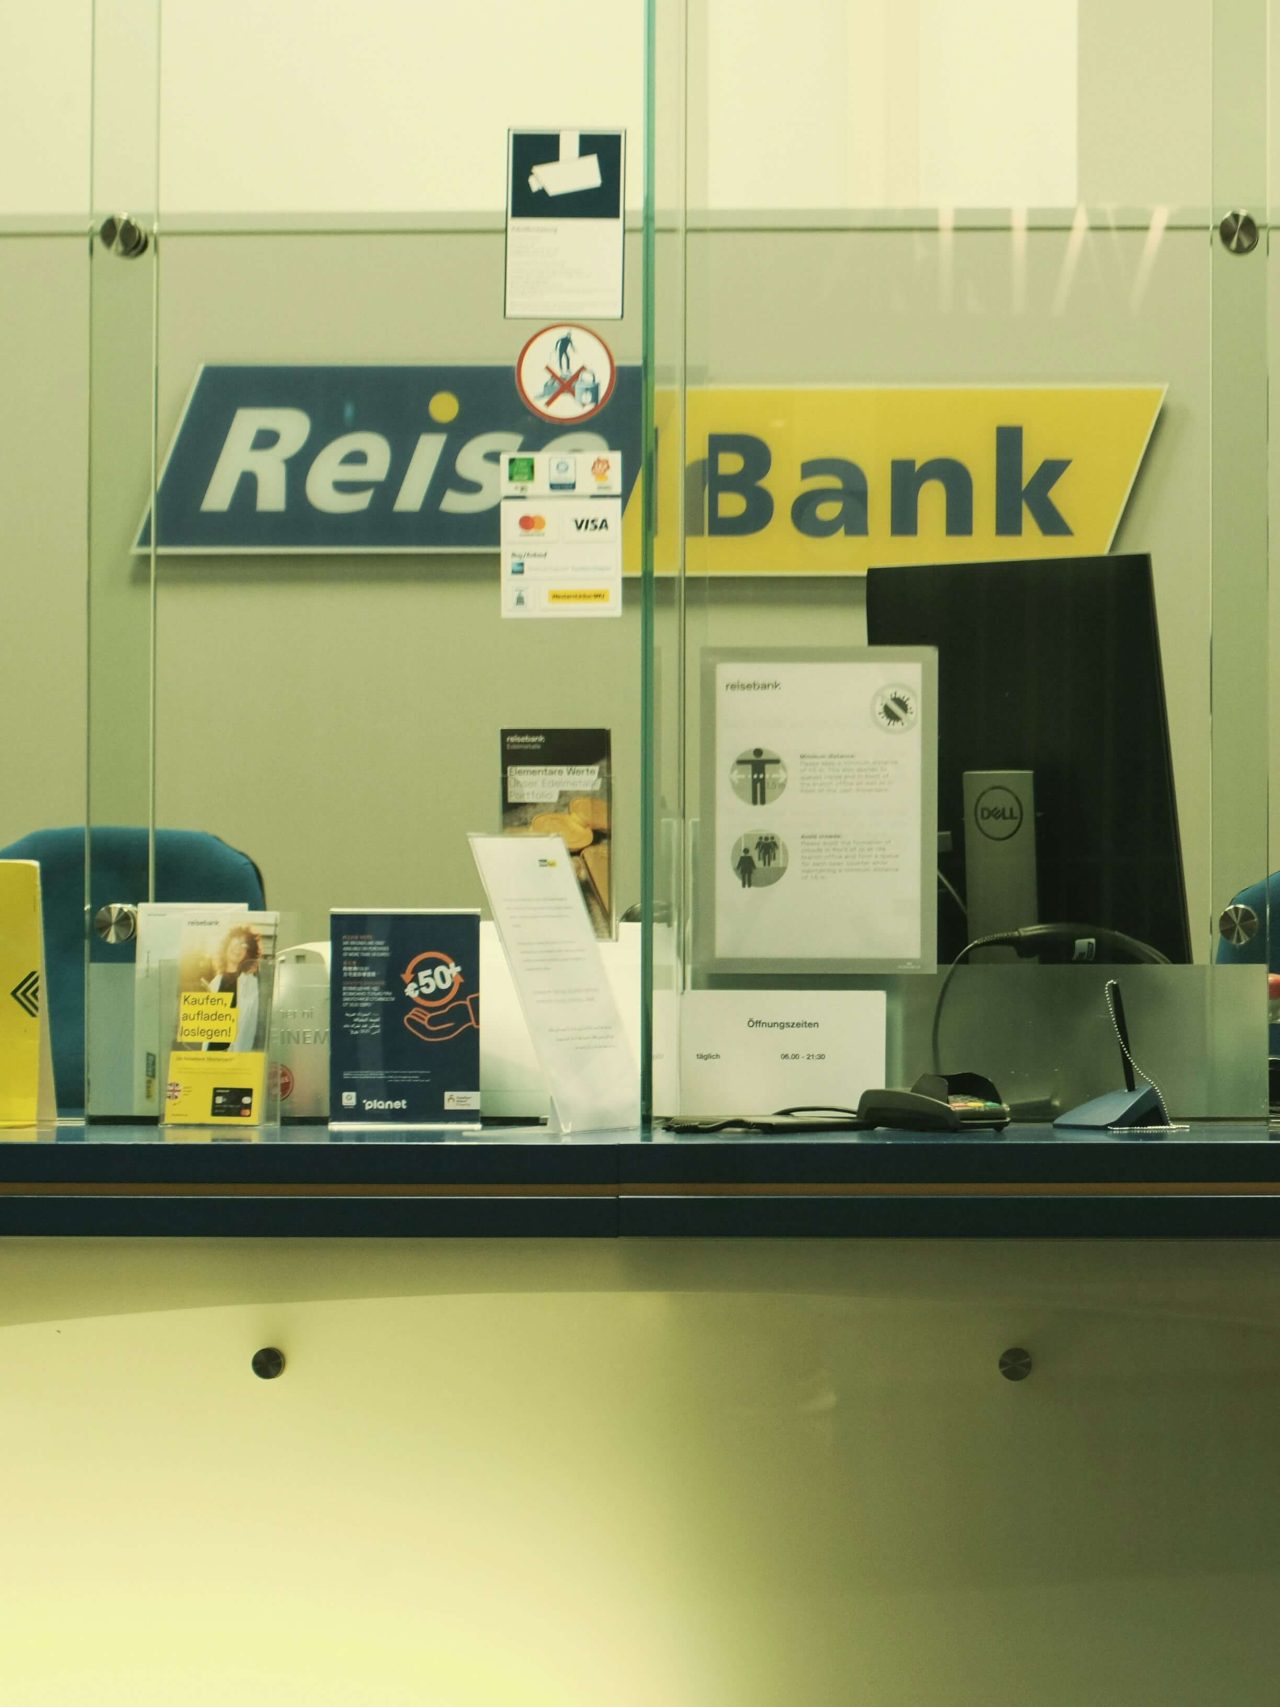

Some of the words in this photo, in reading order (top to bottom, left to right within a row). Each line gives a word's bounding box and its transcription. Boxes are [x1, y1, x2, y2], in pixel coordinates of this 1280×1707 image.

[707, 425, 1074, 538] Bank
[574, 519, 609, 531] VISA
[725, 680, 782, 691] reisebank
[509, 767, 563, 777] Elementare
[566, 767, 596, 777] Werte
[981, 806, 1018, 820] DELL
[404, 962, 461, 998] €50+
[183, 995, 227, 1007] Kaufen,
[182, 1010, 235, 1023] aufladen,
[747, 1018, 819, 1030] Öffnungszeiten
[181, 1026, 231, 1039] loslegen!
[696, 1053, 721, 1061] täglich
